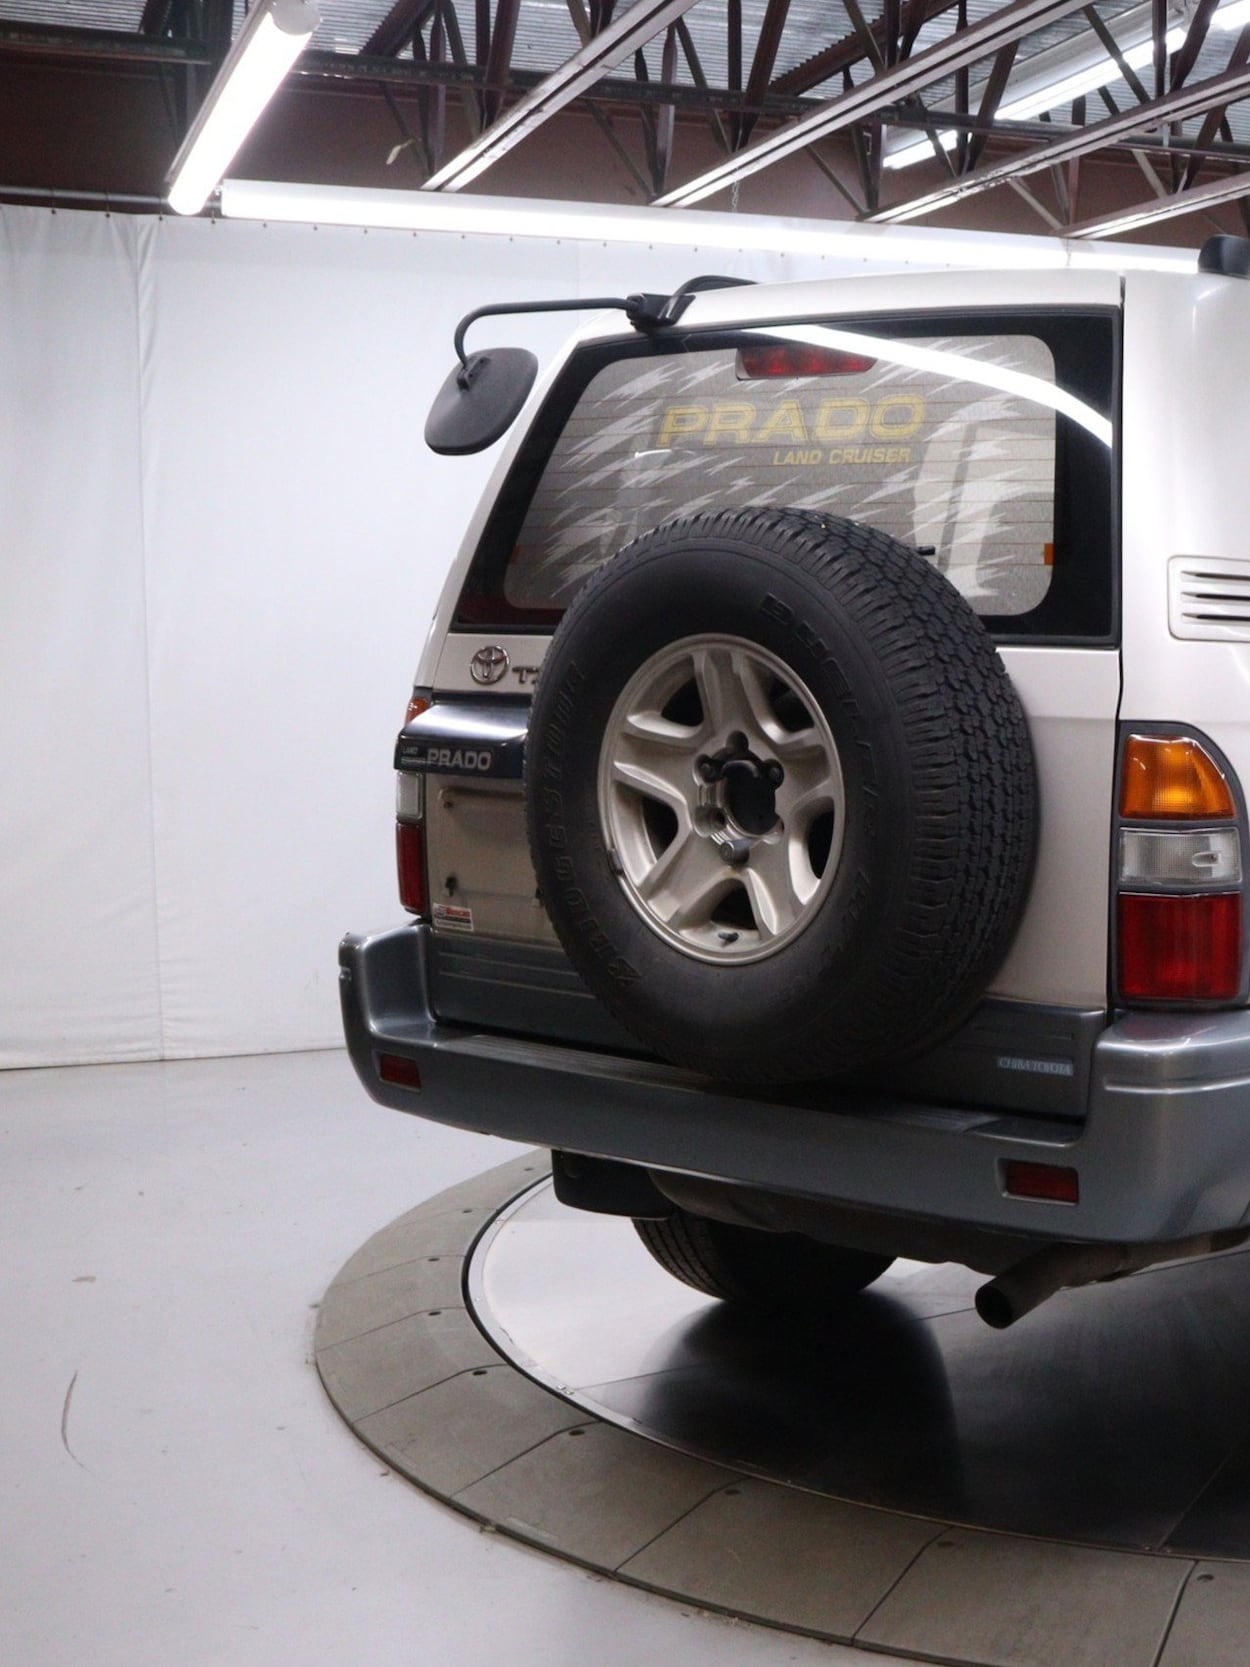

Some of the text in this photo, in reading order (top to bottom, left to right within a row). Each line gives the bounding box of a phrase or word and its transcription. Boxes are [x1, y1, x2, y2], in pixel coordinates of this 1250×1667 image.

[657, 395, 926, 447] PRADO
[773, 448, 911, 466] LAND CRUISER
[427, 747, 491, 770] PRADO
